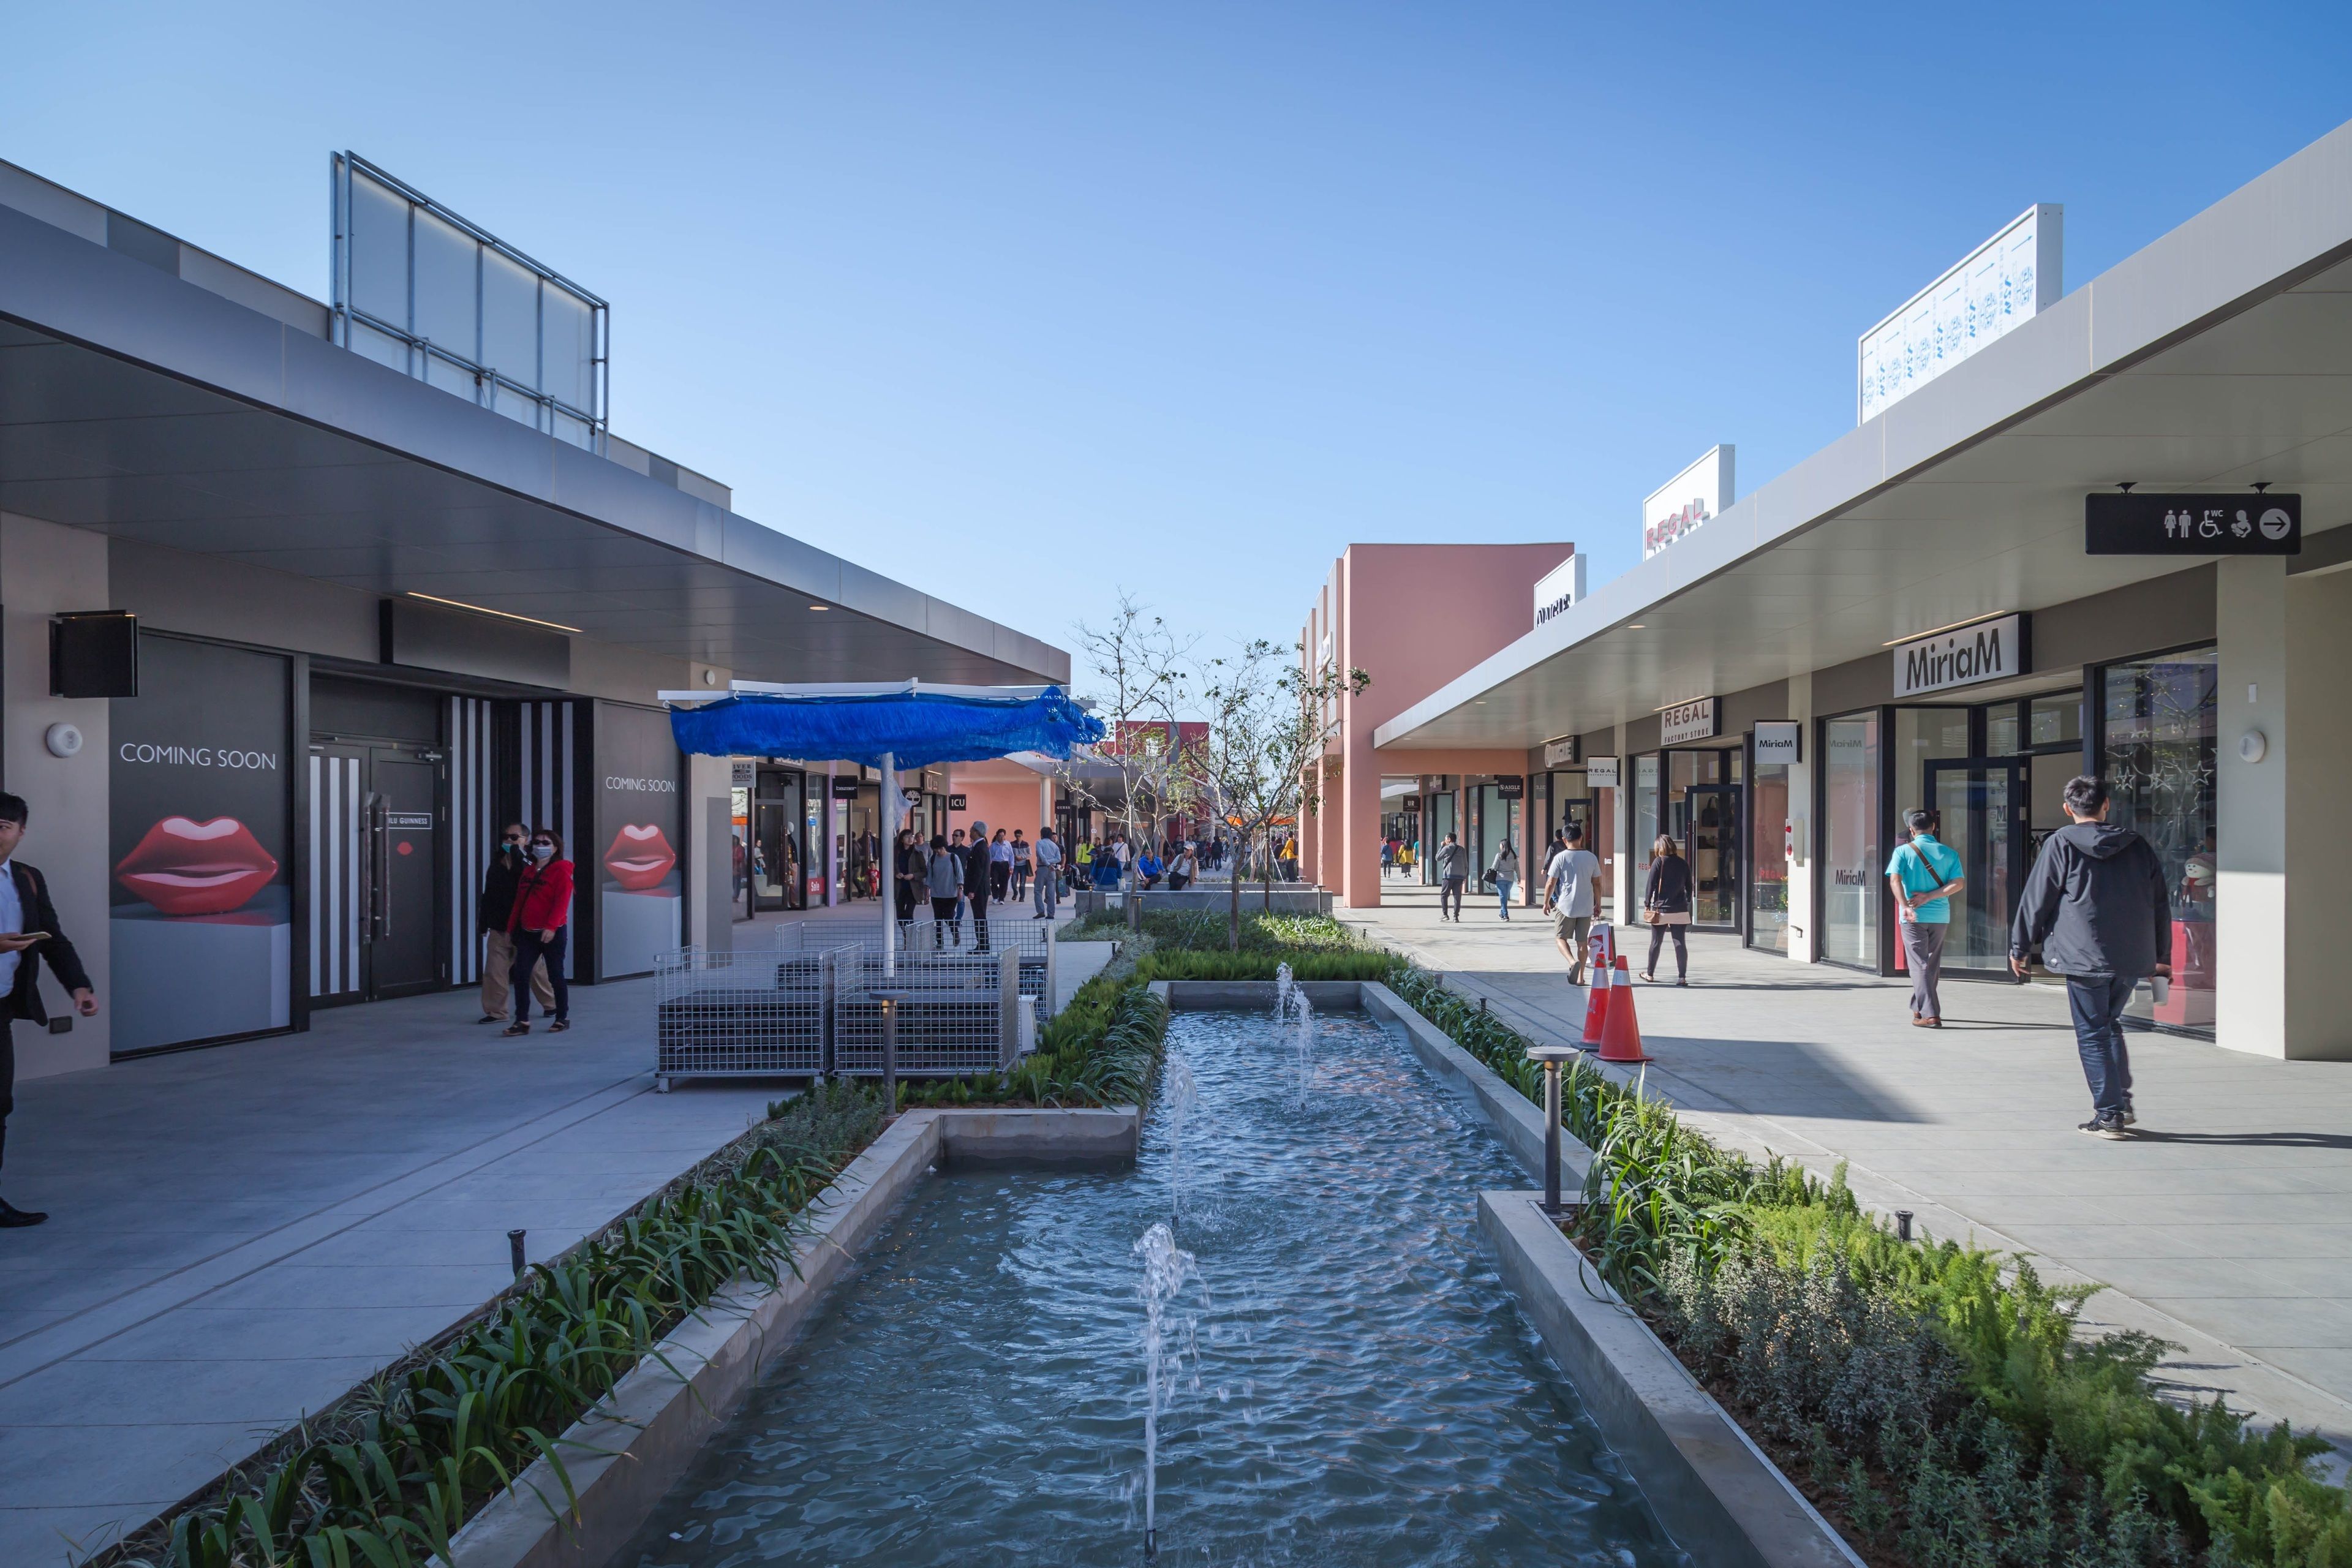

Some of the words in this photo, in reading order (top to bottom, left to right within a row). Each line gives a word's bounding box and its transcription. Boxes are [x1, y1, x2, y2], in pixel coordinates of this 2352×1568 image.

[1646, 498, 1710, 550] REGAL
[1906, 628, 2002, 690] MiriaM
[1665, 703, 1709, 728] REGAL
[1664, 733, 1687, 744] FACTORY
[1691, 728, 1709, 738] STORE
[120, 743, 211, 766] COMING
[217, 750, 276, 770] SOON
[606, 777, 646, 791] COMING
[648, 779, 675, 793] SOON
[811, 881, 820, 892] Sale
[1836, 870, 1866, 886] MiriaM
